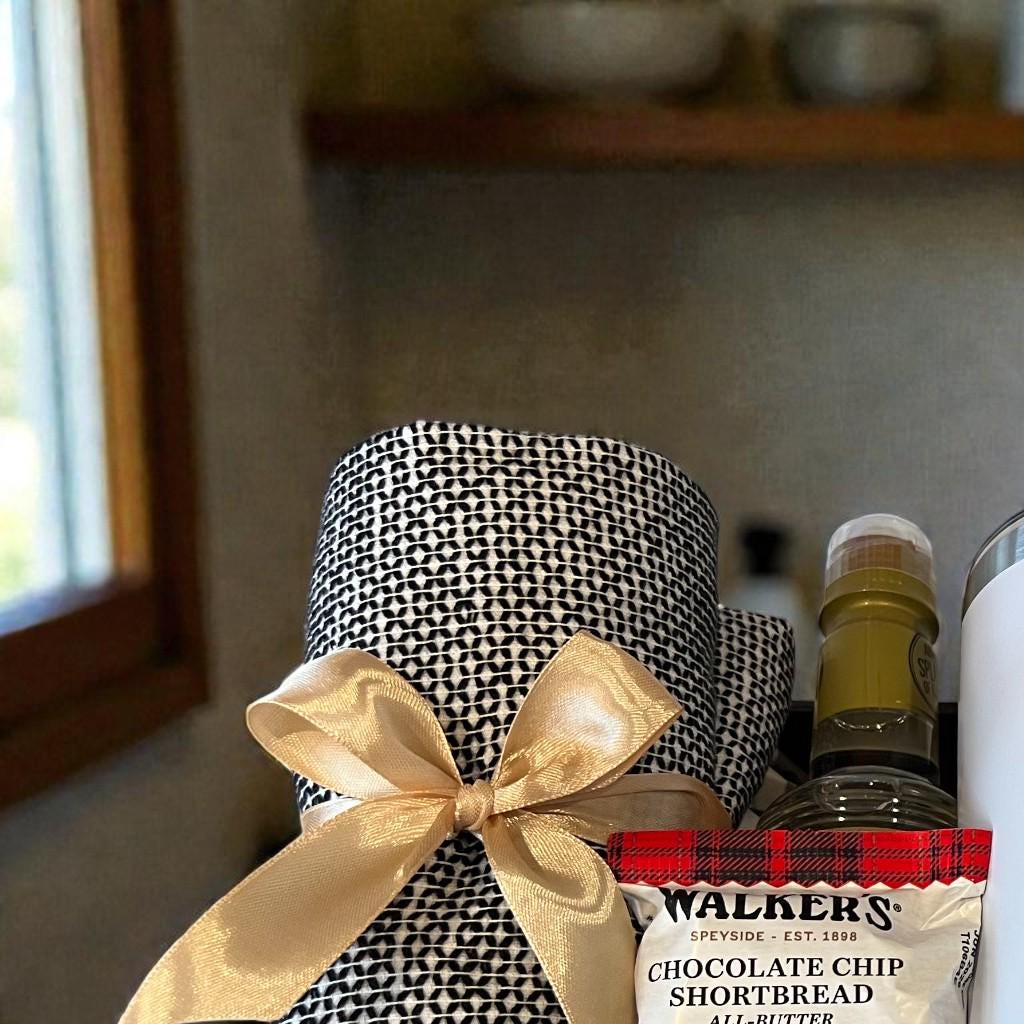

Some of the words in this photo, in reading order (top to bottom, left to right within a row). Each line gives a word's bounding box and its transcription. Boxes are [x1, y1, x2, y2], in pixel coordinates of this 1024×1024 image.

[690, 930, 765, 942] SPEYSIDE
[784, 930, 817, 942] EST.
[822, 930, 858, 942] 1898
[648, 958, 824, 982] CHOCOLATE
[832, 957, 905, 977] CHIP
[669, 984, 874, 1007] SHORTBREAD
